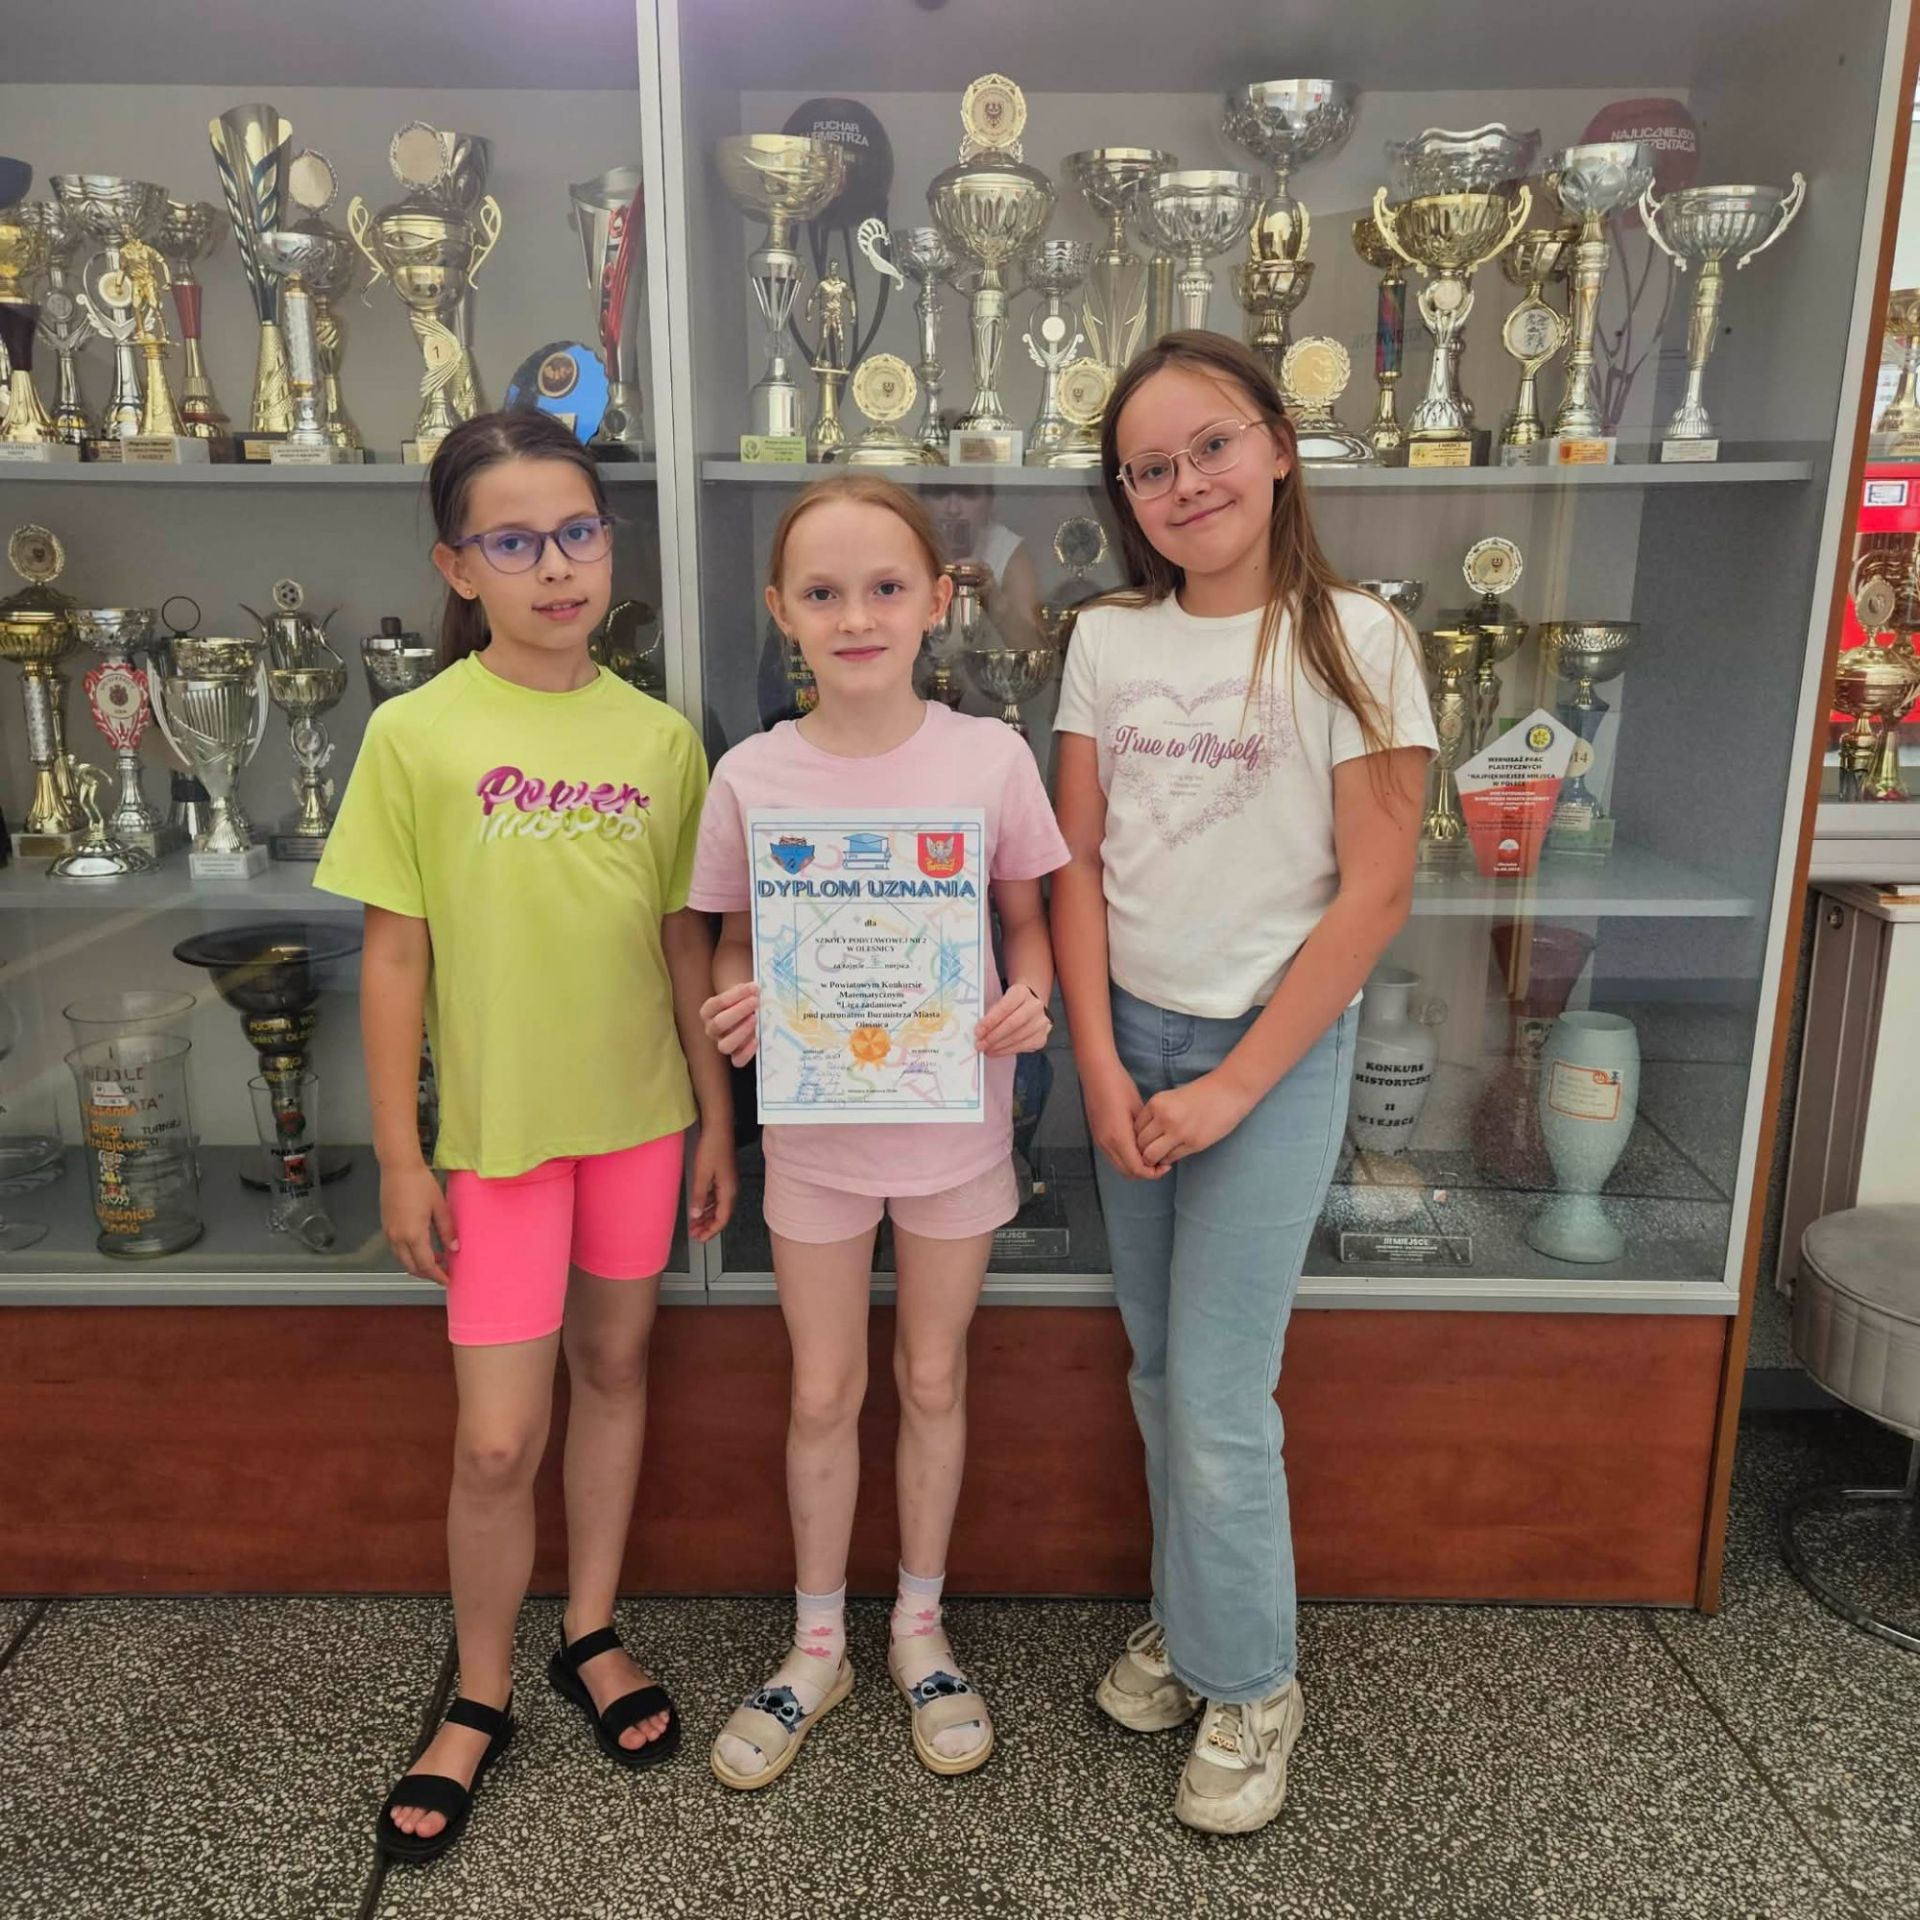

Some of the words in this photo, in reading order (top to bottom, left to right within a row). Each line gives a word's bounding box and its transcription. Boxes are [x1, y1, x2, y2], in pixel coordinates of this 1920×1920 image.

[813, 120, 860, 133] PUCHAR
[1112, 724, 1165, 756] True
[1165, 738, 1186, 758] to
[1187, 732, 1264, 771] Myself
[477, 766, 650, 816] Power
[758, 880, 861, 898] DYPLOM
[867, 880, 977, 898] UZNANIA
[864, 919, 877, 928] dla
[829, 981, 880, 991] Powiatowym
[881, 981, 922, 989] Konkursie
[839, 991, 904, 999] Matematycznym
[803, 1011, 818, 1020] pod
[913, 1010, 940, 1018] Miasta
[1365, 1062, 1424, 1073] KONKURS
[1357, 1114, 1414, 1127] MIEJSCE
